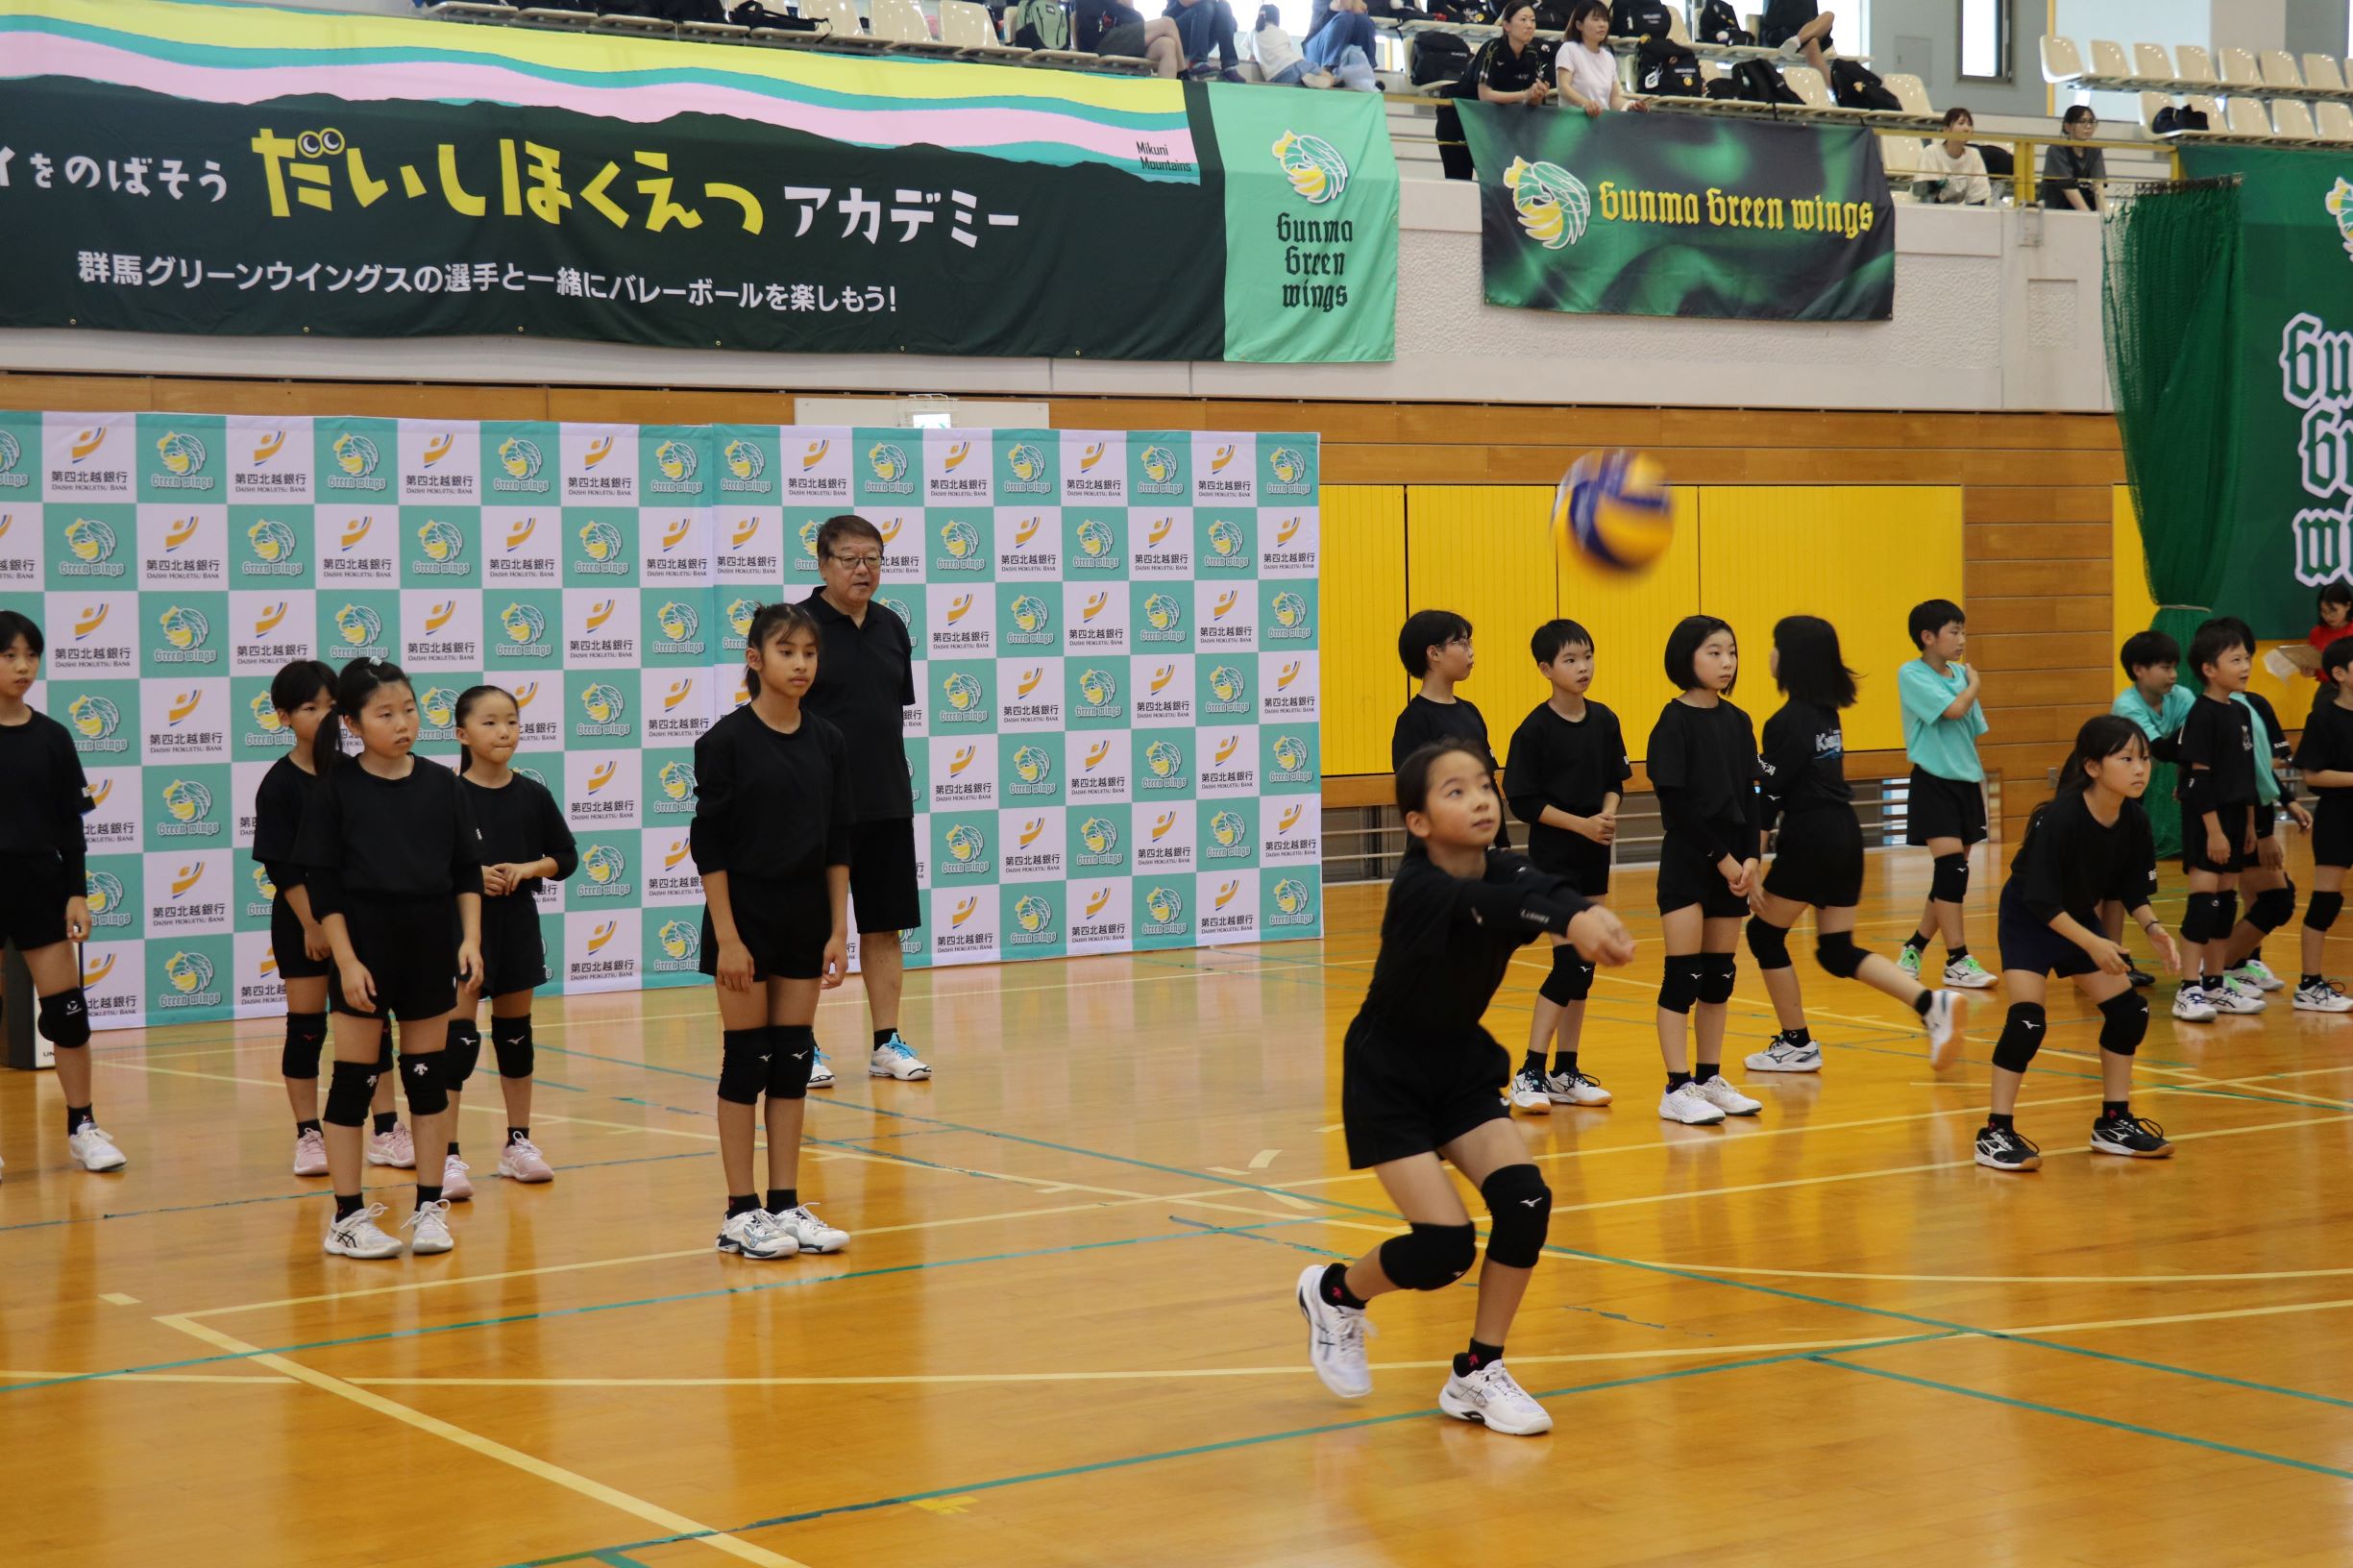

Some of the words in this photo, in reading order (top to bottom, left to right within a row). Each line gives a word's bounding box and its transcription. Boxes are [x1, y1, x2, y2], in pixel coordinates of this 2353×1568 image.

[1136, 140, 1168, 156] Mikuni
[1140, 157, 1192, 172] Mountains
[1599, 181, 1700, 224] Gunma
[1706, 187, 1784, 230] Green
[1791, 195, 1874, 239] wings
[784, 186, 1019, 248] アカデミー
[1276, 212, 1353, 243] Gunma
[1285, 246, 1345, 276] Green
[1283, 280, 1348, 312] wings
[51, 471, 128, 483] 第四北越銀行
[234, 473, 306, 485] 第四北越銀行
[405, 475, 474, 487] 第四北越銀行
[568, 477, 632, 489] 第四北越銀行
[788, 478, 847, 489] 第四北越銀行
[930, 478, 988, 490] 第四北越銀行
[1066, 478, 1121, 490] 第四北越銀行
[1198, 480, 1251, 491] 第四北越銀行
[717, 555, 777, 568] 第四北越銀行
[1000, 553, 1057, 565] 第四北越銀行
[1135, 553, 1189, 565] 第四北越銀行
[1263, 551, 1315, 563] 第四北越銀行
[146, 559, 220, 572] 第四北越銀行
[323, 558, 392, 571] 第四北越銀行
[489, 558, 555, 571] 第四北越銀行
[647, 558, 708, 570] 第四北越銀行
[932, 630, 990, 643] 第四北越銀行
[1068, 628, 1124, 640] 第四北越銀行
[1199, 625, 1253, 637] 第四北越銀行
[236, 644, 308, 657] 第四北越銀行
[407, 642, 476, 654] 第四北越銀行
[569, 639, 633, 651] 第四北越銀行
[55, 647, 132, 660] 第四北越銀行
[1137, 700, 1190, 712] 第四北越銀行
[1264, 695, 1315, 708] 第四北越銀行
[1003, 703, 1060, 717] 第四北越銀行
[649, 718, 710, 731] 第四北越銀行
[149, 731, 223, 747] 第四北越銀行
[1070, 775, 1125, 789] 第四北越銀行
[1201, 770, 1254, 784] 第四北越銀行
[935, 782, 993, 796] 第四北越銀行
[571, 799, 634, 814] 第四北越銀行
[1265, 837, 1317, 852] 第四北越銀行
[1138, 845, 1191, 859] 第四北越銀行
[1005, 853, 1061, 867] 第四北越銀行
[153, 902, 226, 919] 第四北越銀行
[1201, 913, 1254, 929] 第四北越銀行
[1071, 921, 1126, 938] 第四北越銀行
[937, 932, 993, 947] 第四北越銀行
[570, 958, 635, 975] 第四北越銀行
